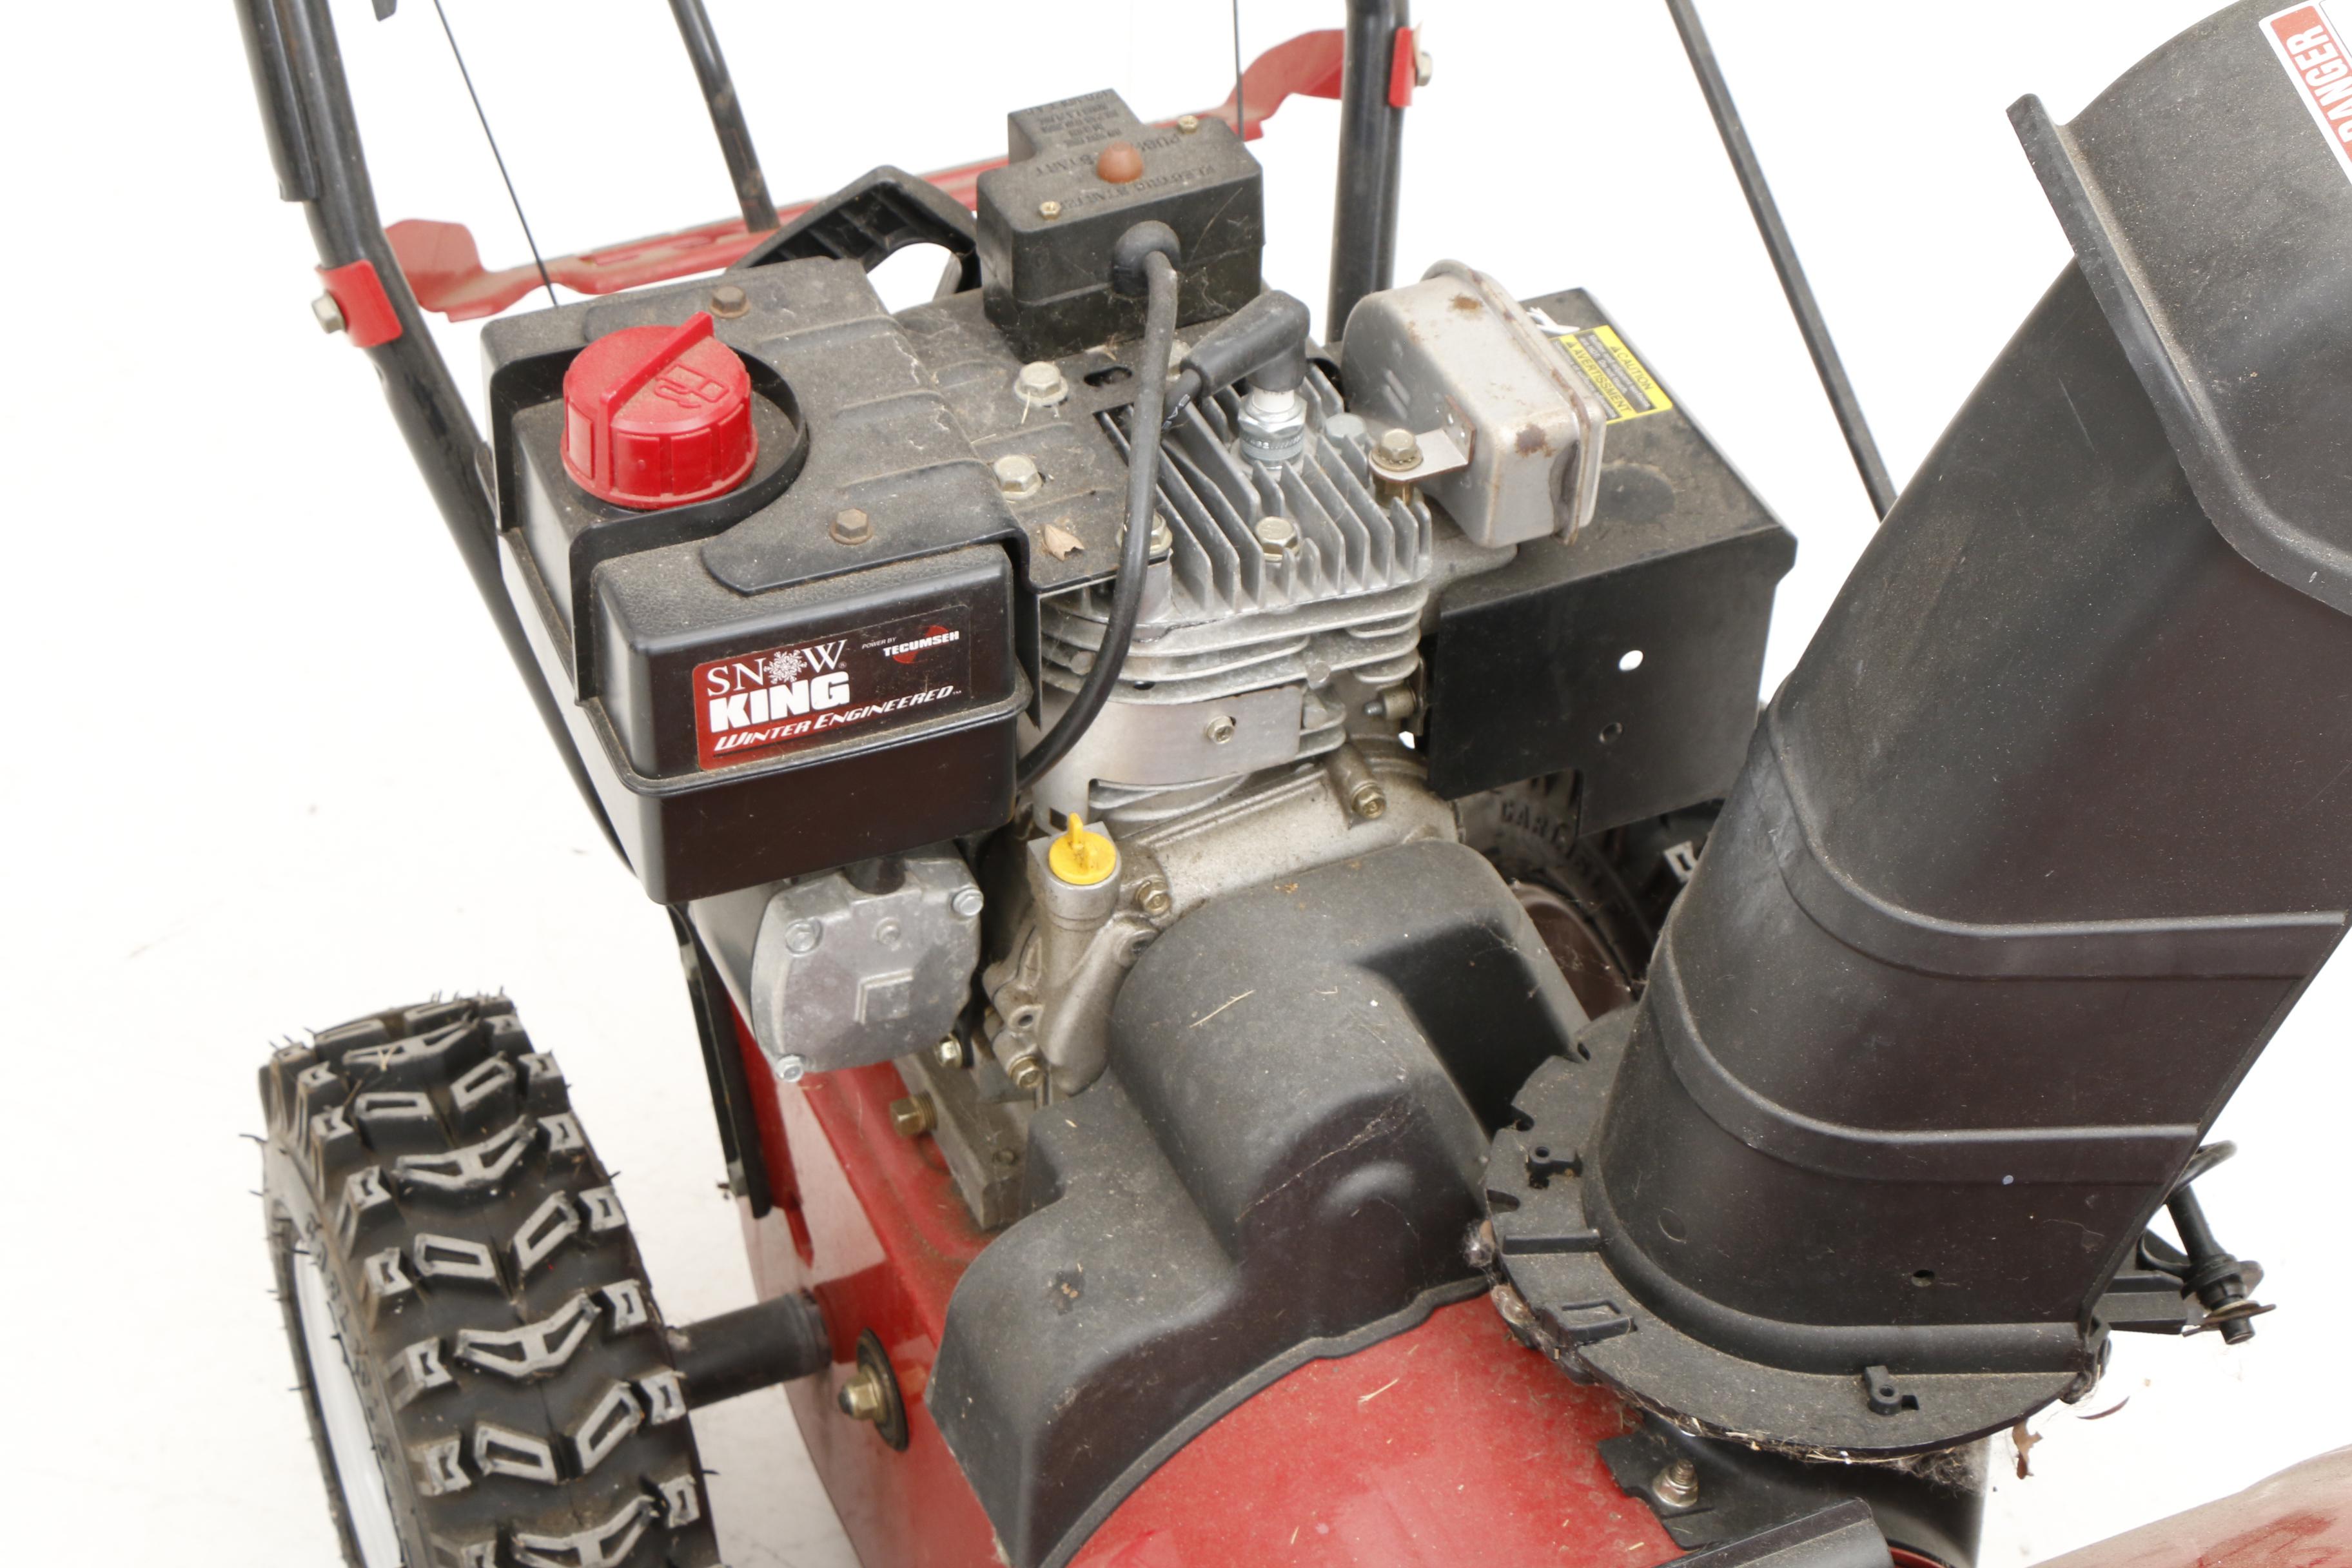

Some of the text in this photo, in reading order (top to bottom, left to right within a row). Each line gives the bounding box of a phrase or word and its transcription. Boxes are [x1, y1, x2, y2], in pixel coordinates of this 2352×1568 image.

[1618, 352, 1652, 390] CAUTION
[862, 639, 887, 649] POWER
[882, 631, 960, 657] TECUMSEH
[709, 671, 850, 734] KING
[713, 685, 954, 752] WINTER ENGINEERED
